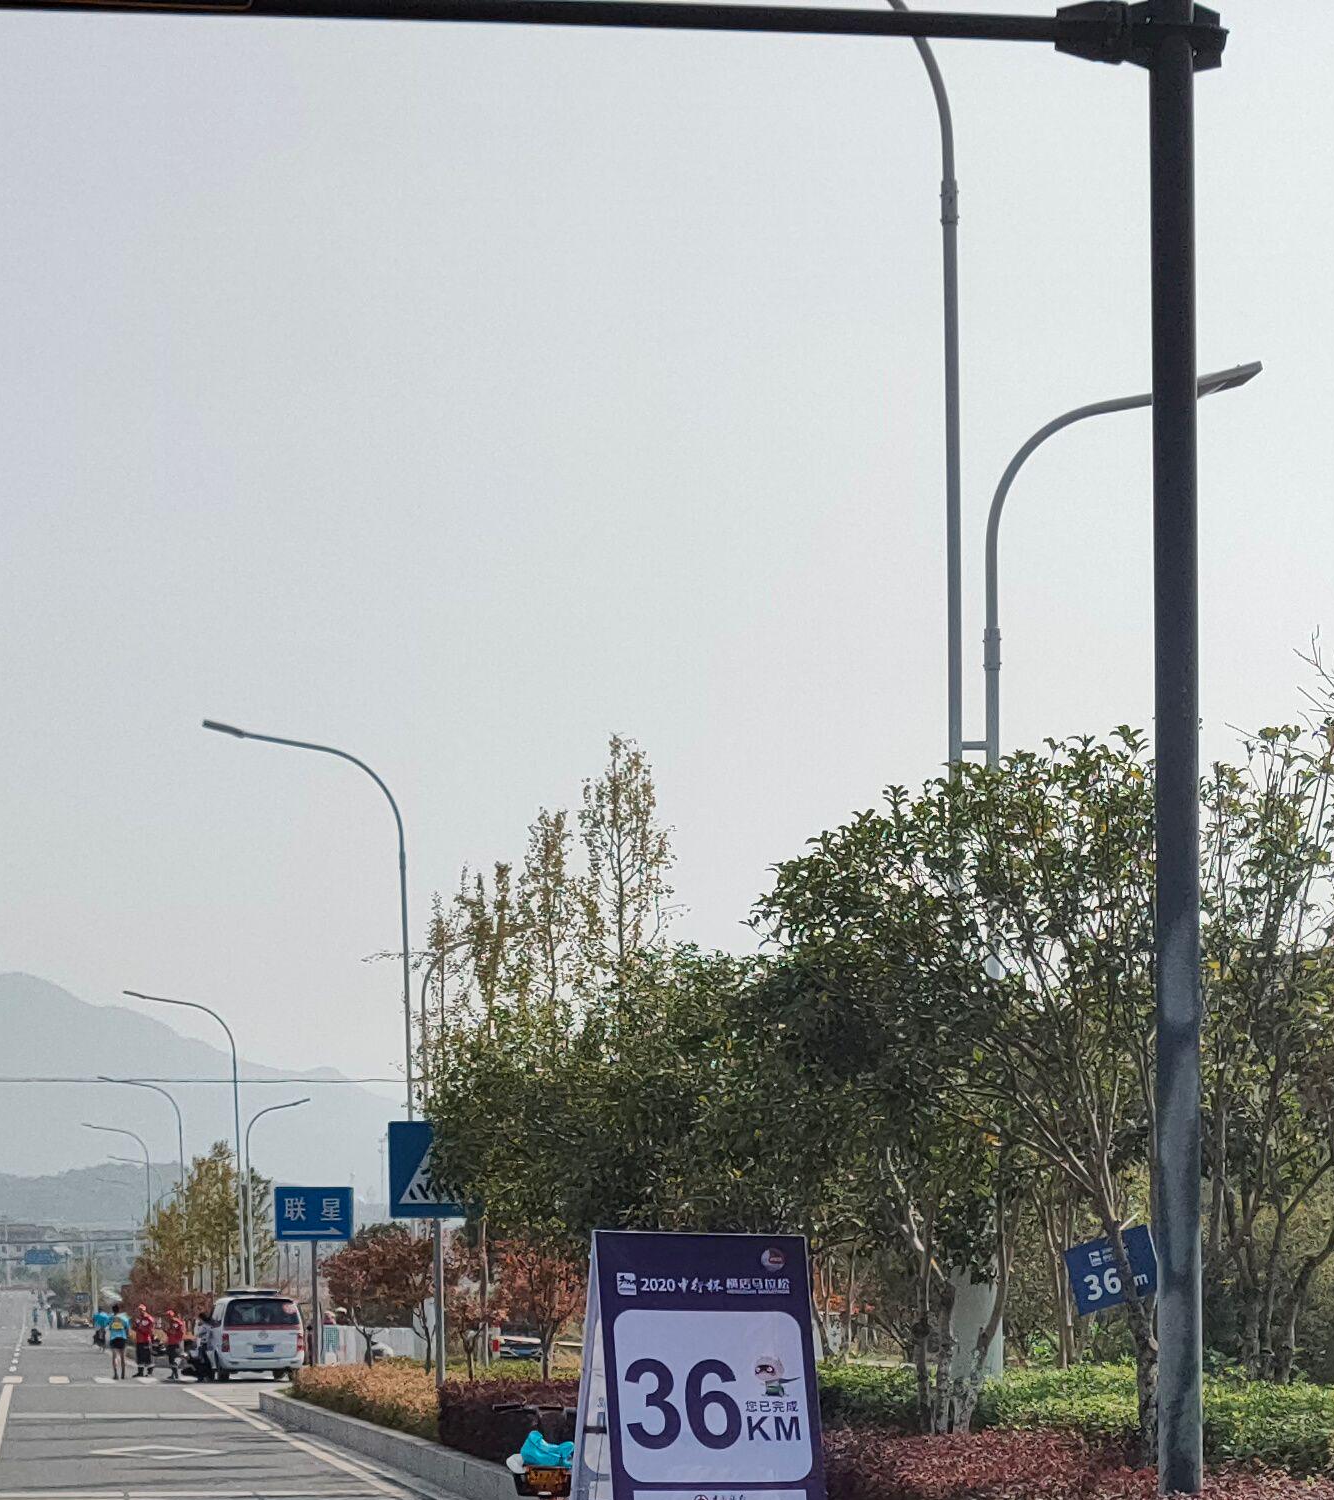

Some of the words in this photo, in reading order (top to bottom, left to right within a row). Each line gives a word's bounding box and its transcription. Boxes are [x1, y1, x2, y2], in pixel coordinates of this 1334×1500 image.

[284, 1197, 343, 1221] 联星
[640, 1278, 676, 1291] 2020
[1084, 1268, 1121, 1300] 36
[624, 1358, 742, 1450] 36
[745, 1400, 799, 1412] 您已完成
[747, 1416, 801, 1441] KM
